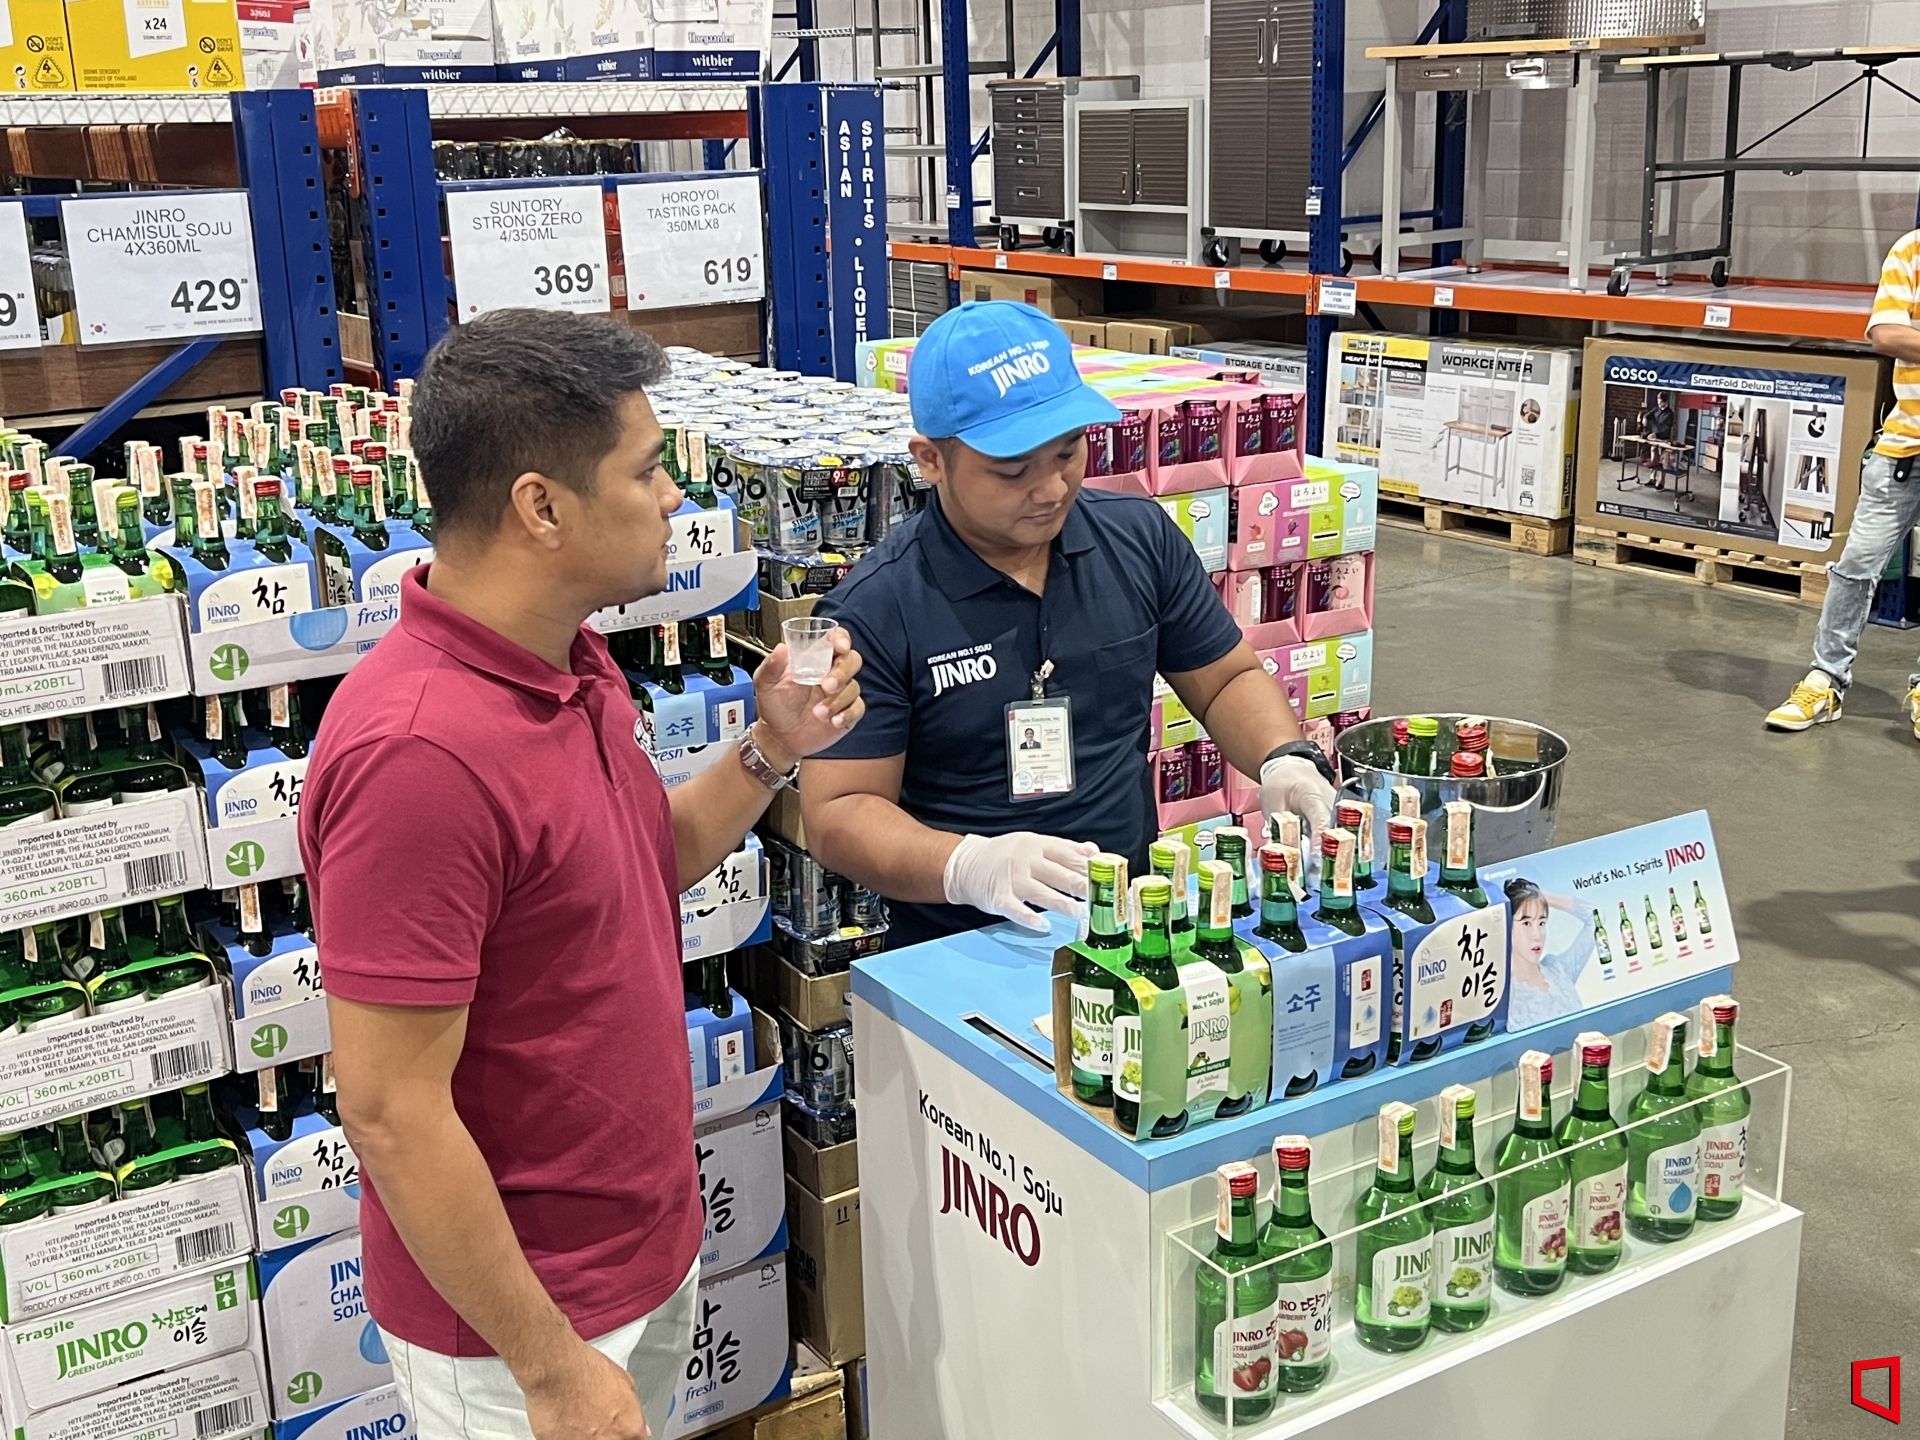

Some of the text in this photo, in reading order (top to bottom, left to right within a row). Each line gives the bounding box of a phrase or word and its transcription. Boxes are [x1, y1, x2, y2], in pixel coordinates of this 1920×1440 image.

[688, 32, 735, 43] Hoegaarden
[692, 55, 733, 67] witbier
[422, 71, 461, 80] witbier
[838, 120, 853, 198] ASIAN
[861, 120, 875, 229] SPIRITS
[661, 189, 719, 203] HOROYOI
[132, 208, 186, 224] JINRO
[489, 198, 562, 215] SUNTORY
[647, 203, 737, 219] TASTING PACK
[472, 210, 583, 230] STRONG ZERO
[666, 218, 720, 232] 350MLX8
[86, 222, 232, 242] CHAMISUL SOJU
[499, 227, 558, 242] 4/350ML
[124, 240, 201, 256] 4X360ML
[533, 263, 594, 296] 369
[703, 256, 752, 285] 619
[171, 278, 241, 313] 429
[968, 351, 1008, 376] KOREAN
[1225, 358, 1301, 374] STORAGE CABINET
[990, 352, 1050, 398] JINRO
[1610, 366, 1657, 382] COSCO
[1693, 376, 1738, 389] SmartFold
[1741, 380, 1772, 392] Deluxe
[1294, 486, 1327, 497] ほろよい
[687, 521, 716, 555] 참
[252, 577, 287, 615] 참
[369, 584, 399, 601] JINRO
[207, 604, 240, 620] JINRO
[358, 607, 398, 627] fresh
[928, 650, 957, 664] KOREAN
[974, 643, 992, 653] SOJU
[931, 655, 997, 697] JINRO
[666, 717, 694, 737] 소주
[269, 771, 304, 807] 참
[225, 798, 257, 816] JINRO
[1572, 841, 1706, 891] World's No.1 Spirits JINRO
[715, 864, 742, 894] 참
[681, 887, 706, 902] JINRO
[1457, 924, 1488, 968] 참
[1417, 958, 1447, 982] JINRO
[250, 985, 282, 1003] JINRO
[1461, 962, 1498, 1008] 이슬
[1196, 991, 1219, 1001] World's
[1209, 997, 1225, 1007] SOJU
[1286, 984, 1321, 1014] 소주
[1190, 1015, 1229, 1045] JINRO
[312, 1139, 347, 1171] 참
[919, 1089, 1062, 1216] Korean No.1 Soju
[1706, 1141, 1734, 1151] JINRO
[1665, 1156, 1691, 1169] JINRO
[271, 1166, 302, 1186] JINRO
[75, 1200, 170, 1231] Imported & Distributed by
[940, 1144, 1041, 1267] JINRO
[80, 1221, 121, 1238] PHILIPPINES
[138, 1211, 150, 1221] TAX
[151, 1207, 167, 1218] AND
[167, 1203, 184, 1215] DUTY
[185, 1199, 201, 1210] PAID
[123, 1226, 135, 1236] THE
[136, 1215, 171, 1232] PALISADES
[148, 1224, 162, 1235] SAN
[22, 1294, 59, 1313] PRODUCT
[59, 1294, 68, 1304] OF
[69, 1288, 94, 1301] KOREA
[95, 1282, 111, 1293] HITE
[112, 1276, 132, 1289] JINRO
[148, 1267, 161, 1277] LTD
[25, 1280, 52, 1294] VOL
[152, 1304, 208, 1330] 청포도에
[16, 1320, 75, 1345] Fragile
[173, 1318, 208, 1344] 이슬
[1233, 1329, 1263, 1343] JINRO
[56, 1321, 148, 1381] JINRO
[67, 1349, 144, 1379] GREEN GRAPE SOJU
[686, 1380, 717, 1400] fresh
[687, 1402, 722, 1420] IMPORTED
